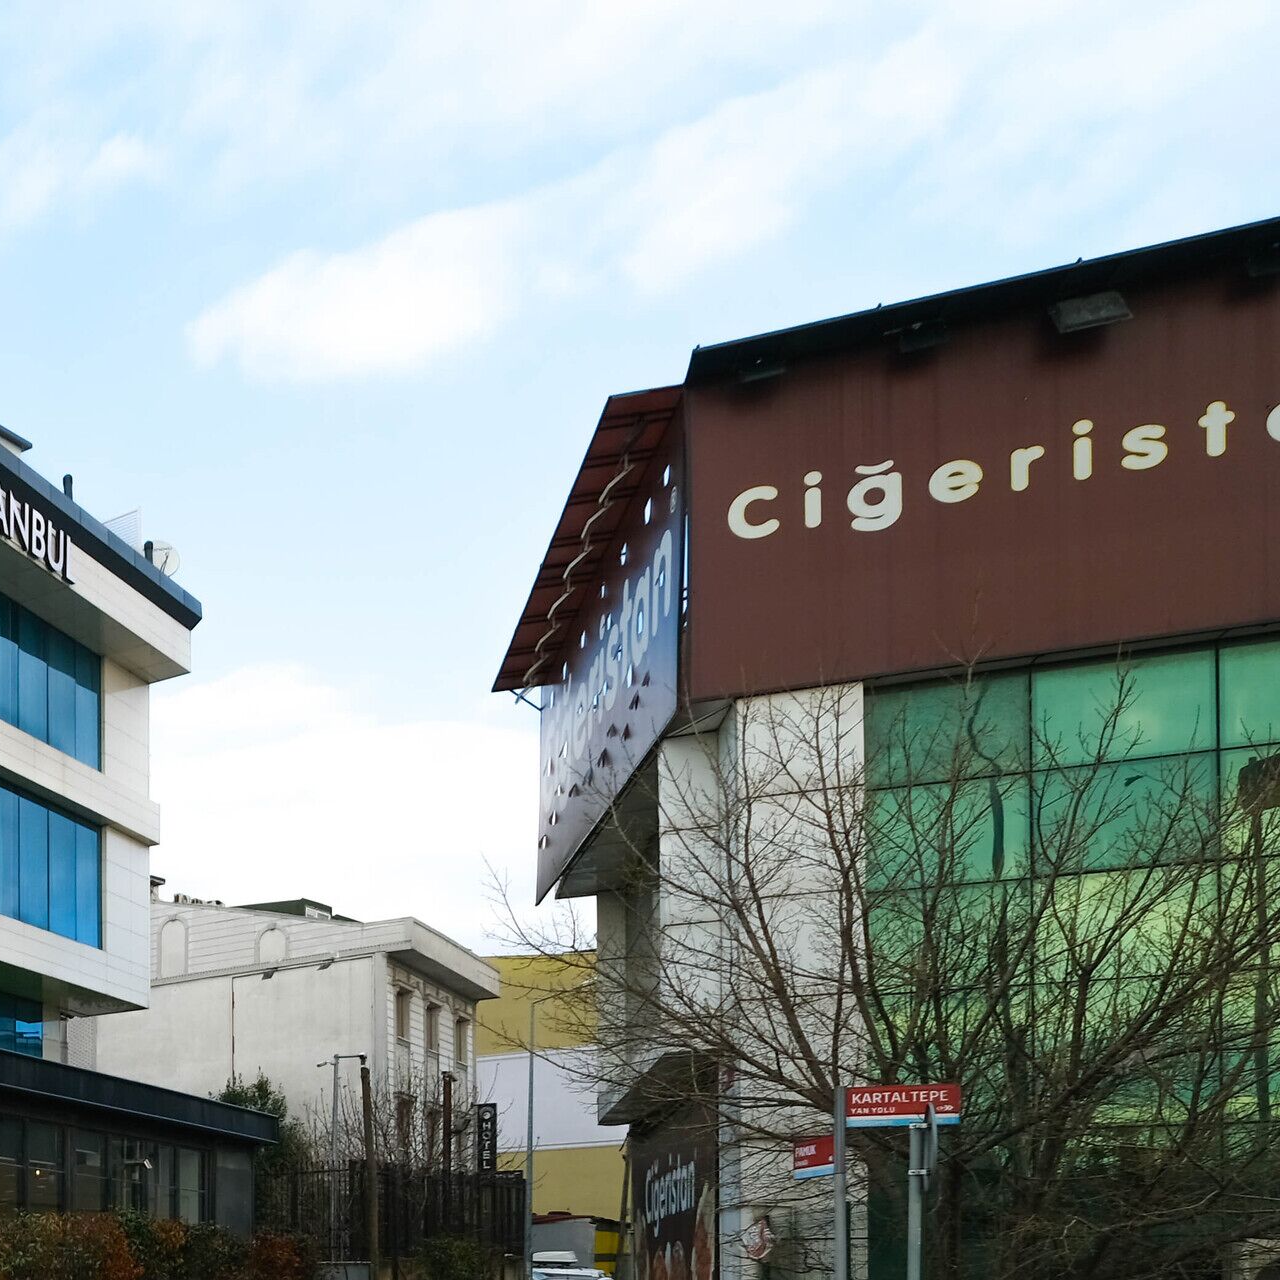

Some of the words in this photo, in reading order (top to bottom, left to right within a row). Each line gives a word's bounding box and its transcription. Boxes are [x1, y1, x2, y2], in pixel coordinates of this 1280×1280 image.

[851, 1090, 949, 1104] KARTALTEPE
[850, 1107, 870, 1115] YAN
[871, 1106, 896, 1114] YOLU
[482, 1121, 491, 1169] HOTEL
